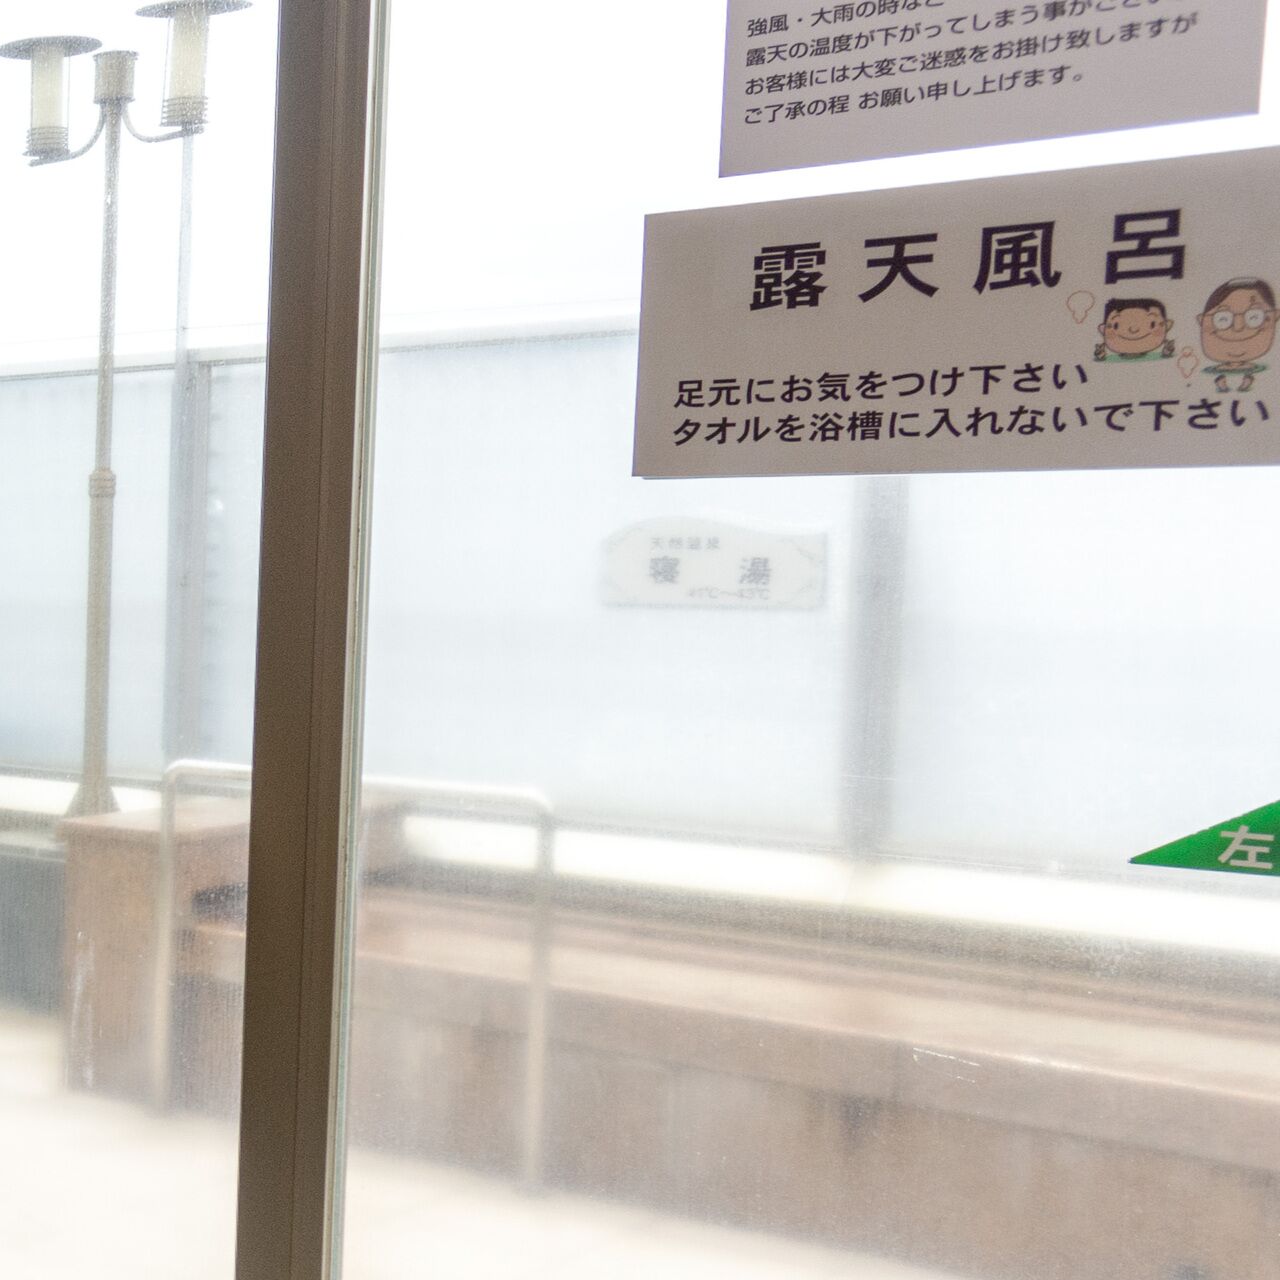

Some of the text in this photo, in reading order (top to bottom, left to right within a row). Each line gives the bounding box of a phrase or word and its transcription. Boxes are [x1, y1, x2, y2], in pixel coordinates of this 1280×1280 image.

[745, 12, 1198, 95] お客様には大変ご迷惑をお掛け致しますが
[749, 208, 1186, 311] 露天風呂
[675, 361, 1088, 407] 足元にお気をつけ下さい
[673, 397, 1270, 447] タオルを浴槽に入れないで下さい
[1218, 825, 1274, 869] 左
